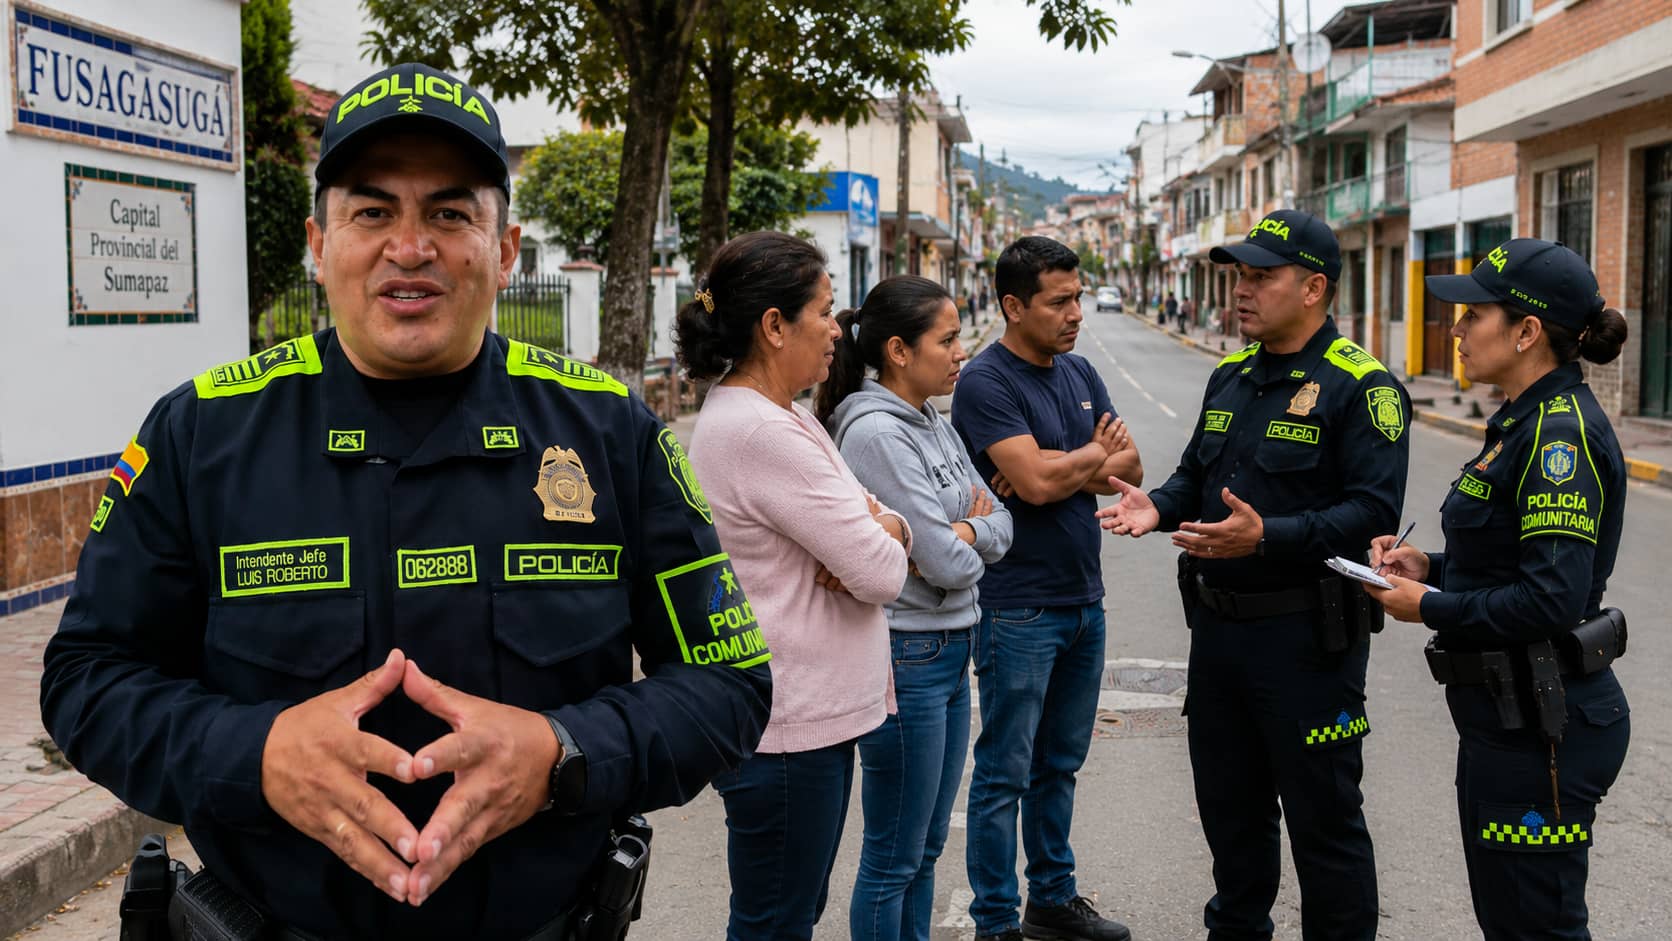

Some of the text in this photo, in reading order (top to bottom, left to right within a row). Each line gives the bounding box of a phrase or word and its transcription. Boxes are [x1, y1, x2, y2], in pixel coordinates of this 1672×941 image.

[27, 43, 225, 137] FUSAGASUGÁ
[336, 73, 491, 125] POLICÍA
[110, 198, 160, 233] Capital
[90, 232, 179, 260] Provincial del
[104, 265, 169, 299] Sumapaz
[1271, 425, 1314, 441] POLICÍA
[1527, 491, 1588, 512] POLICÍA
[236, 548, 327, 569] Intendente Jefe
[405, 554, 468, 579] 062888
[519, 551, 609, 574] POLICÍA
[237, 565, 328, 587] LUIS ROBERTO
